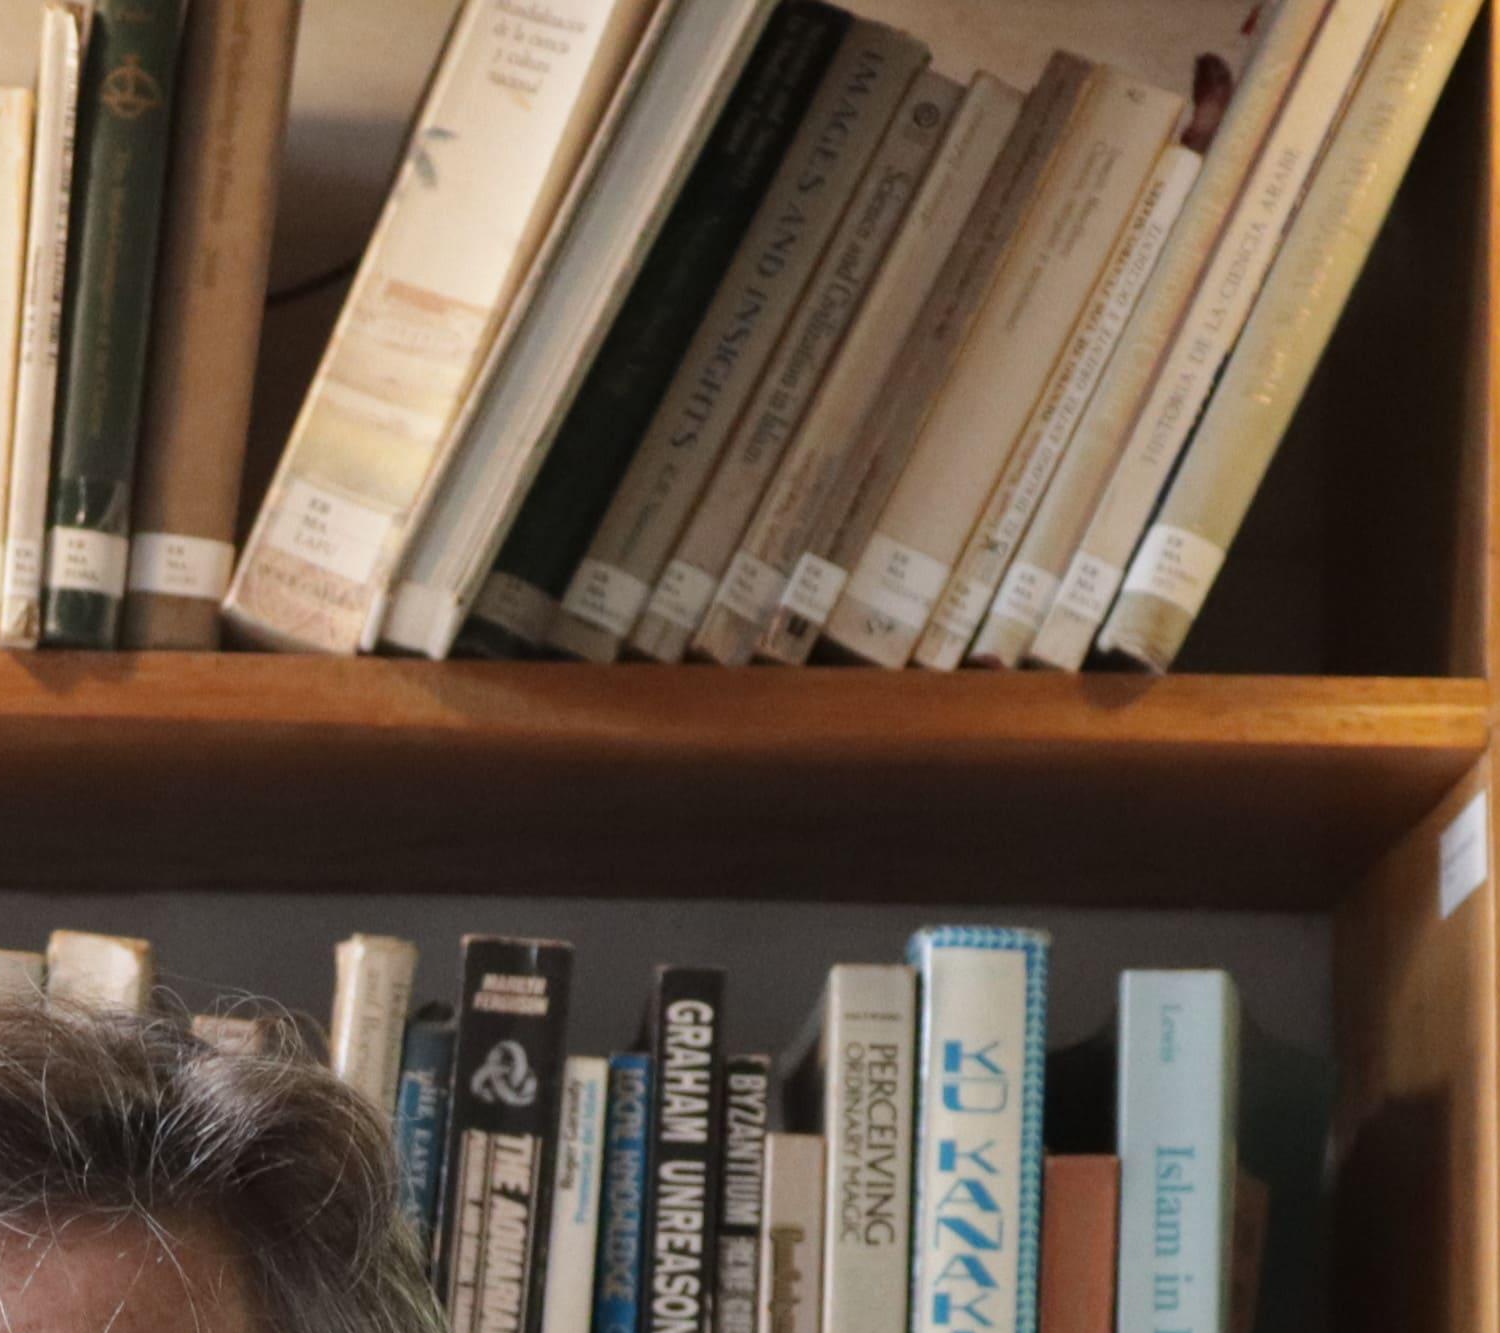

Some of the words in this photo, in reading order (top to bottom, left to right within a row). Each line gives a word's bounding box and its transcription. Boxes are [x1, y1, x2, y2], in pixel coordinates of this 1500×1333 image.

[661, 1000, 712, 1143] GRAHAM
[863, 1043, 898, 1247] PERCEIVING
[1154, 1145, 1195, 1257] Islam
[1154, 1273, 1193, 1310] in
